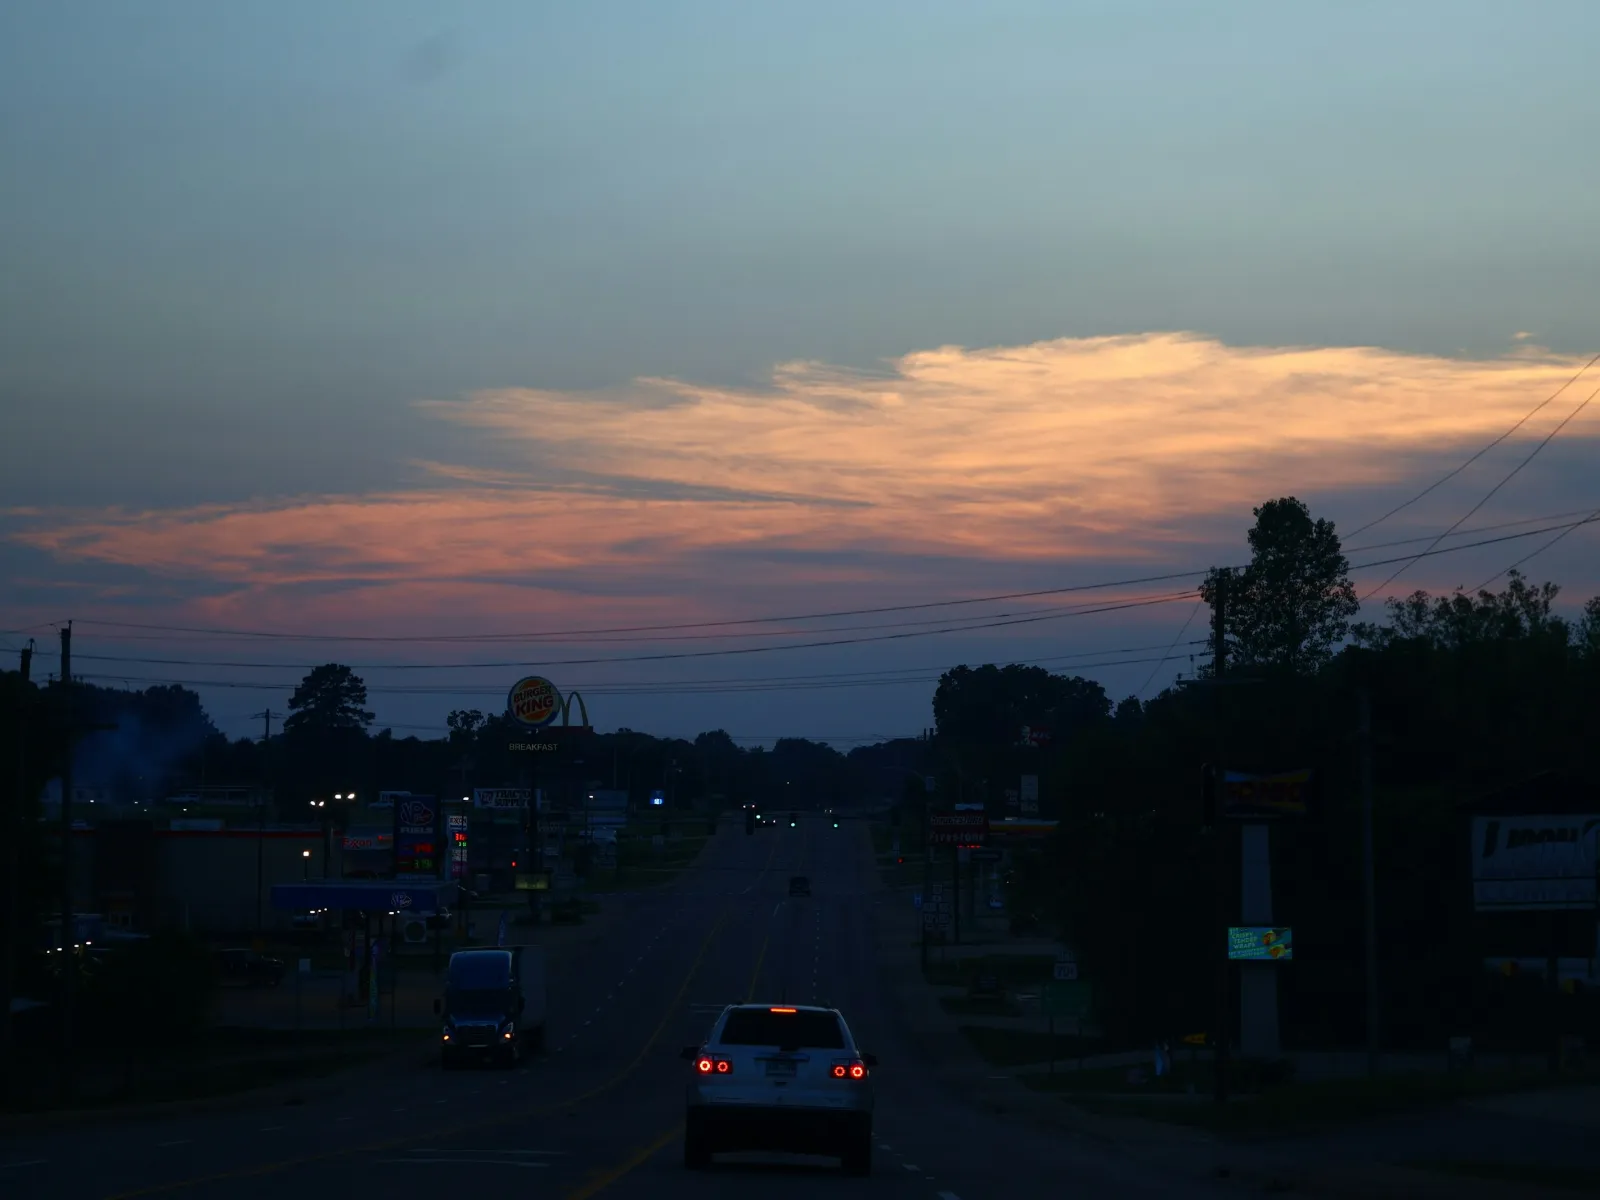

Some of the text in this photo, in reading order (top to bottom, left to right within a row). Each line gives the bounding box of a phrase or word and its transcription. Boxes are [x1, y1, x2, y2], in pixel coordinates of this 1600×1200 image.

[514, 685, 552, 703] BURGER
[515, 695, 554, 717] KING
[508, 743, 558, 751] BREAKFAST
